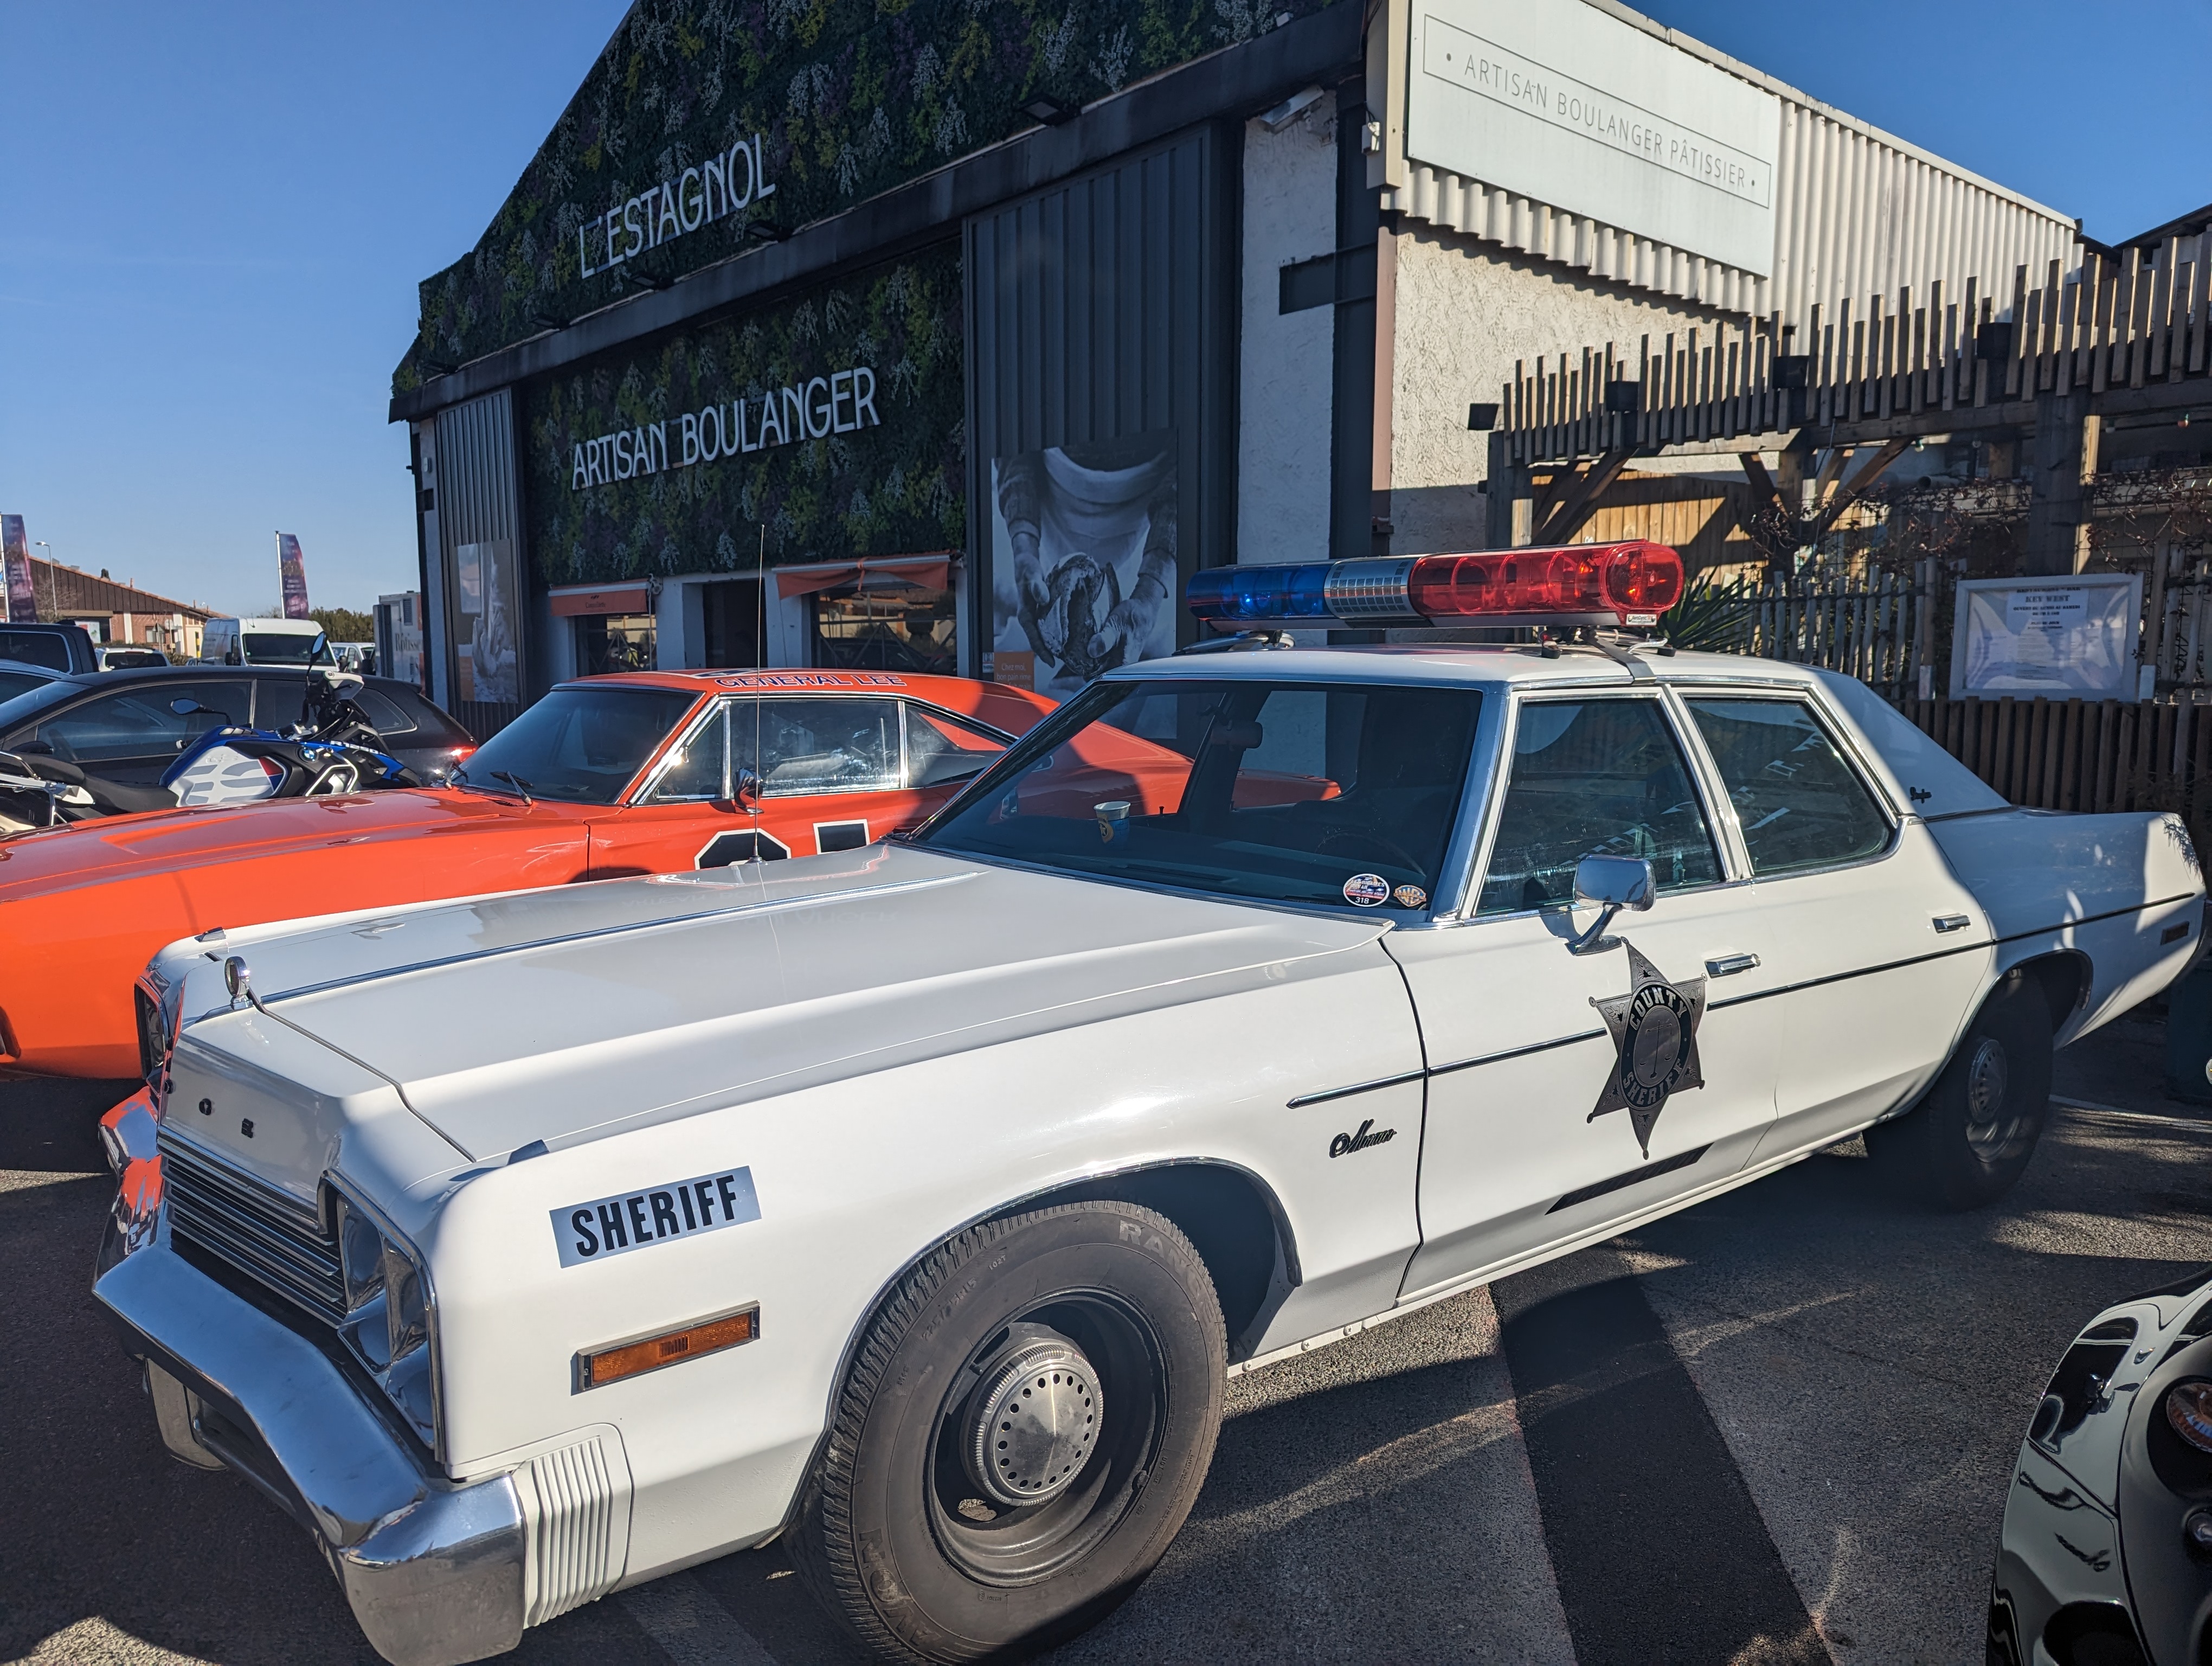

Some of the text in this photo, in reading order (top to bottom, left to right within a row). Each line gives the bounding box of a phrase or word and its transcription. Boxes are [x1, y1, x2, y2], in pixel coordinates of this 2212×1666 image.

[1464, 54, 1746, 189] ARTISAN BOULANGER PÂTISSIER
[579, 133, 776, 279] L'ESTAGNOL
[572, 366, 881, 490] ARTISAN BOULANGER
[715, 675, 908, 688] GENERAL LEE
[1629, 986, 1688, 1030] COUNTY
[1623, 1058, 1683, 1105] SHERIFF
[571, 1175, 737, 1257] SHERIFF
[988, 1254, 1006, 1271] 102T
[859, 1528, 942, 1646] AVON
